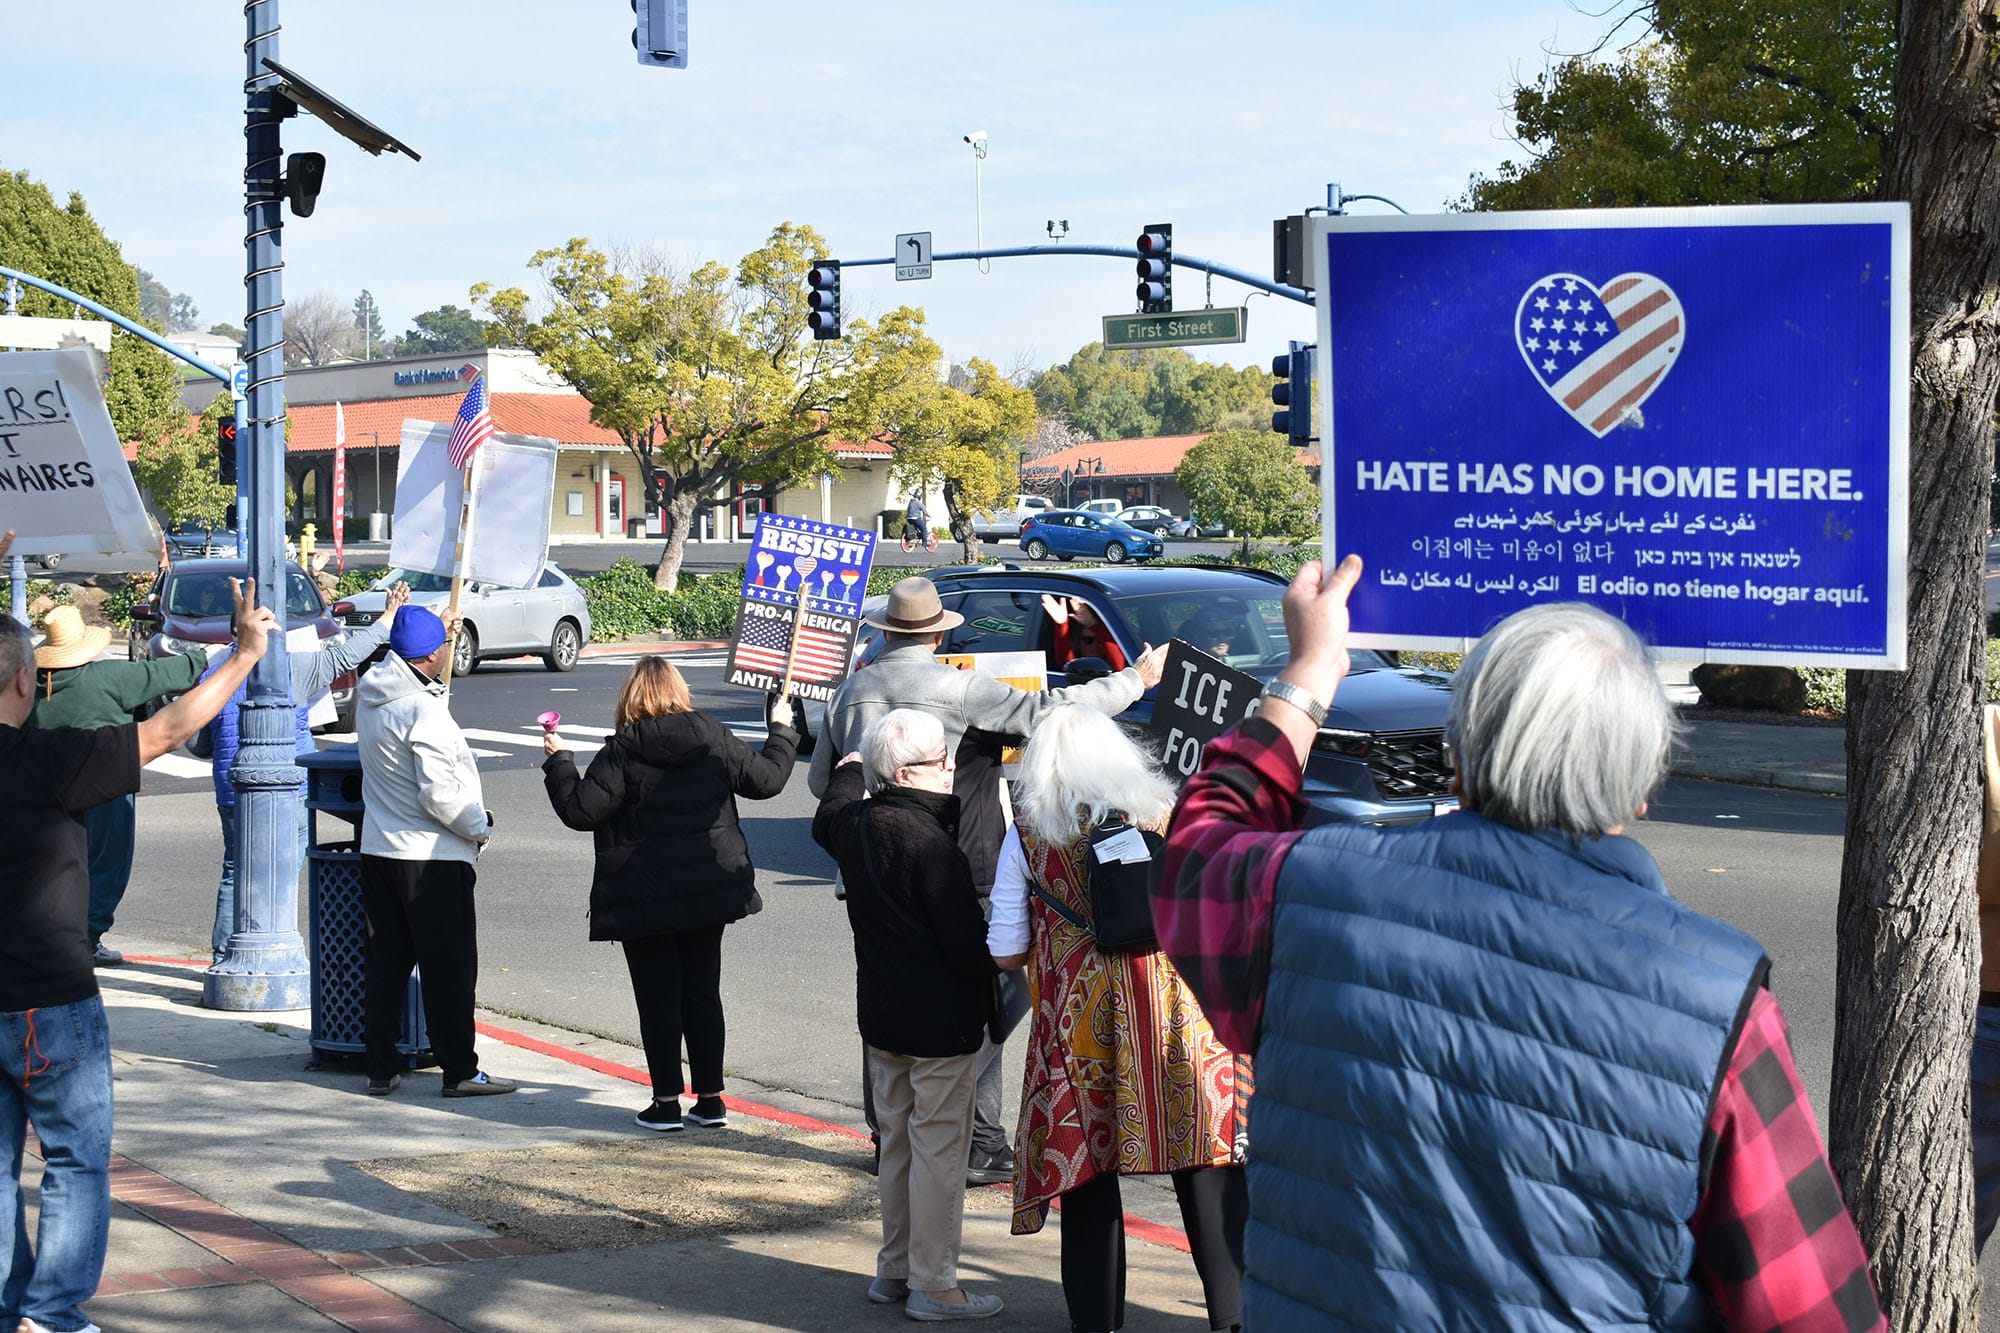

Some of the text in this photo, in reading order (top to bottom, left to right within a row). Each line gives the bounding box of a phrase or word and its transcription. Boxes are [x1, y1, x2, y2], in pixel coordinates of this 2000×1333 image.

[907, 267, 914, 277] U
[1127, 319, 1215, 339] First Street
[394, 370, 415, 386] Bank
[423, 367, 459, 383] America
[0, 380, 71, 422] RS!
[1356, 460, 1863, 501] HATE HAS NO HOME HERE.
[1709, 512, 1756, 536] نفرت
[758, 527, 867, 566] RESIST!
[1502, 538, 1563, 564] 미움이
[1572, 541, 1615, 565] 없다
[1634, 547, 1801, 570] לשנאה אין בית כאן
[1379, 568, 1560, 597] الكره ليس له مكان هنا
[1577, 574, 1869, 608] El odio no tiene hogar aquí.
[744, 601, 852, 635] PRO-AMERICA
[1174, 659, 1233, 725] ICE
[1162, 727, 1206, 777] FO
